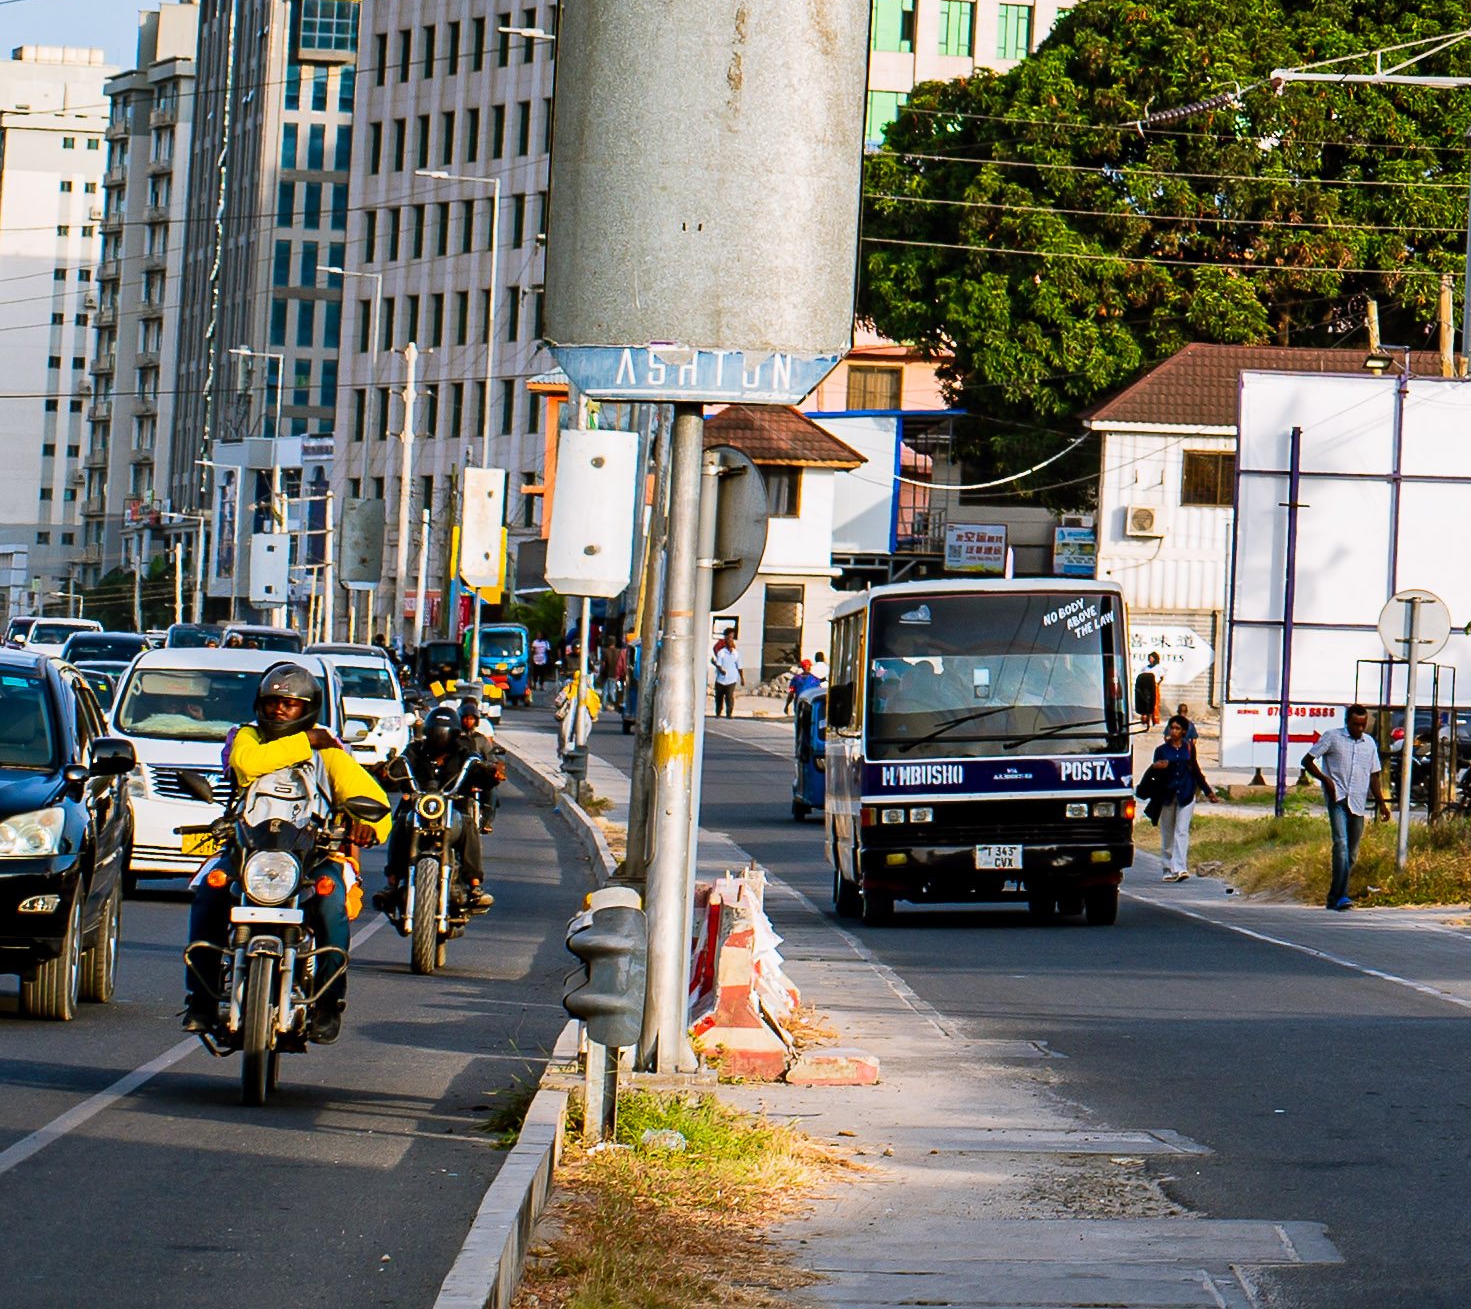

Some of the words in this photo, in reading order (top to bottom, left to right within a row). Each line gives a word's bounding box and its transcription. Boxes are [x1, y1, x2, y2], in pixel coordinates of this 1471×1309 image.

[1043, 611, 1058, 627] NO
[1058, 597, 1085, 621] BODY
[1066, 605, 1098, 631] ABOVE
[1074, 624, 1094, 639] THE
[1094, 610, 1116, 630] LAW
[1060, 760, 1116, 782] POSTA
[994, 858, 1014, 868] CVX
